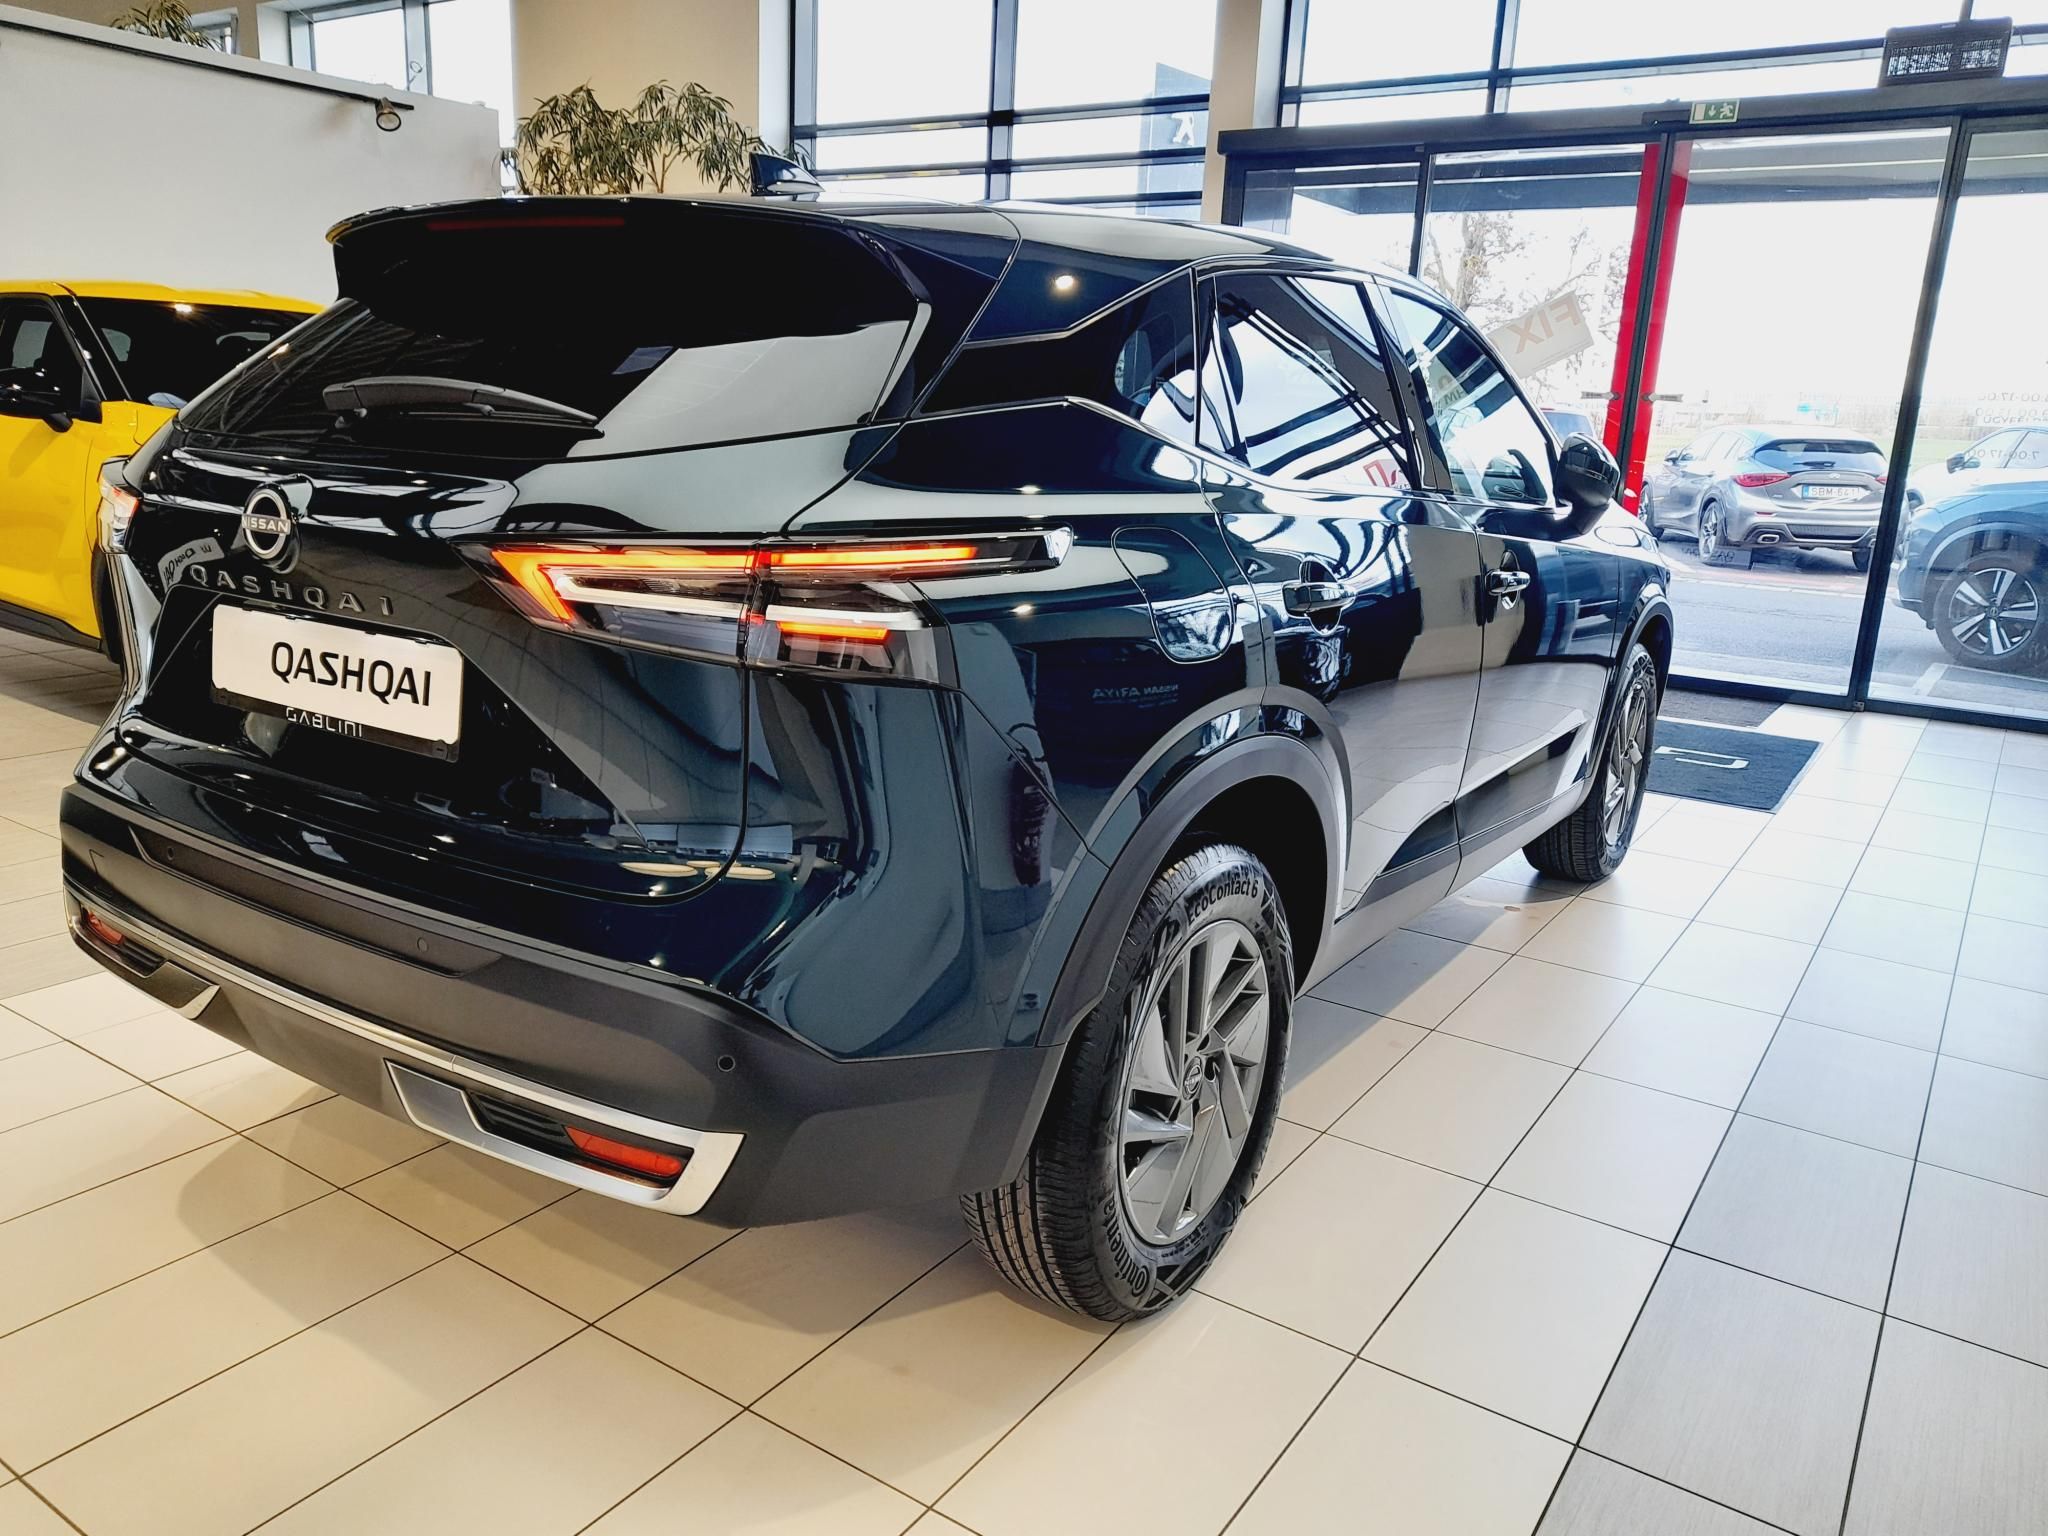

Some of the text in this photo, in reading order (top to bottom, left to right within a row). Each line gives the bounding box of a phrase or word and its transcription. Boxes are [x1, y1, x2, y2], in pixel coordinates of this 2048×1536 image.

[242, 514, 289, 533] NISSAN
[189, 564, 394, 617] QASHQAI
[271, 641, 431, 706] QASHQAI
[285, 707, 363, 738] GABLINI
[1184, 878, 1259, 926] EcoContact 6
[1102, 1191, 1150, 1297] Continenta
